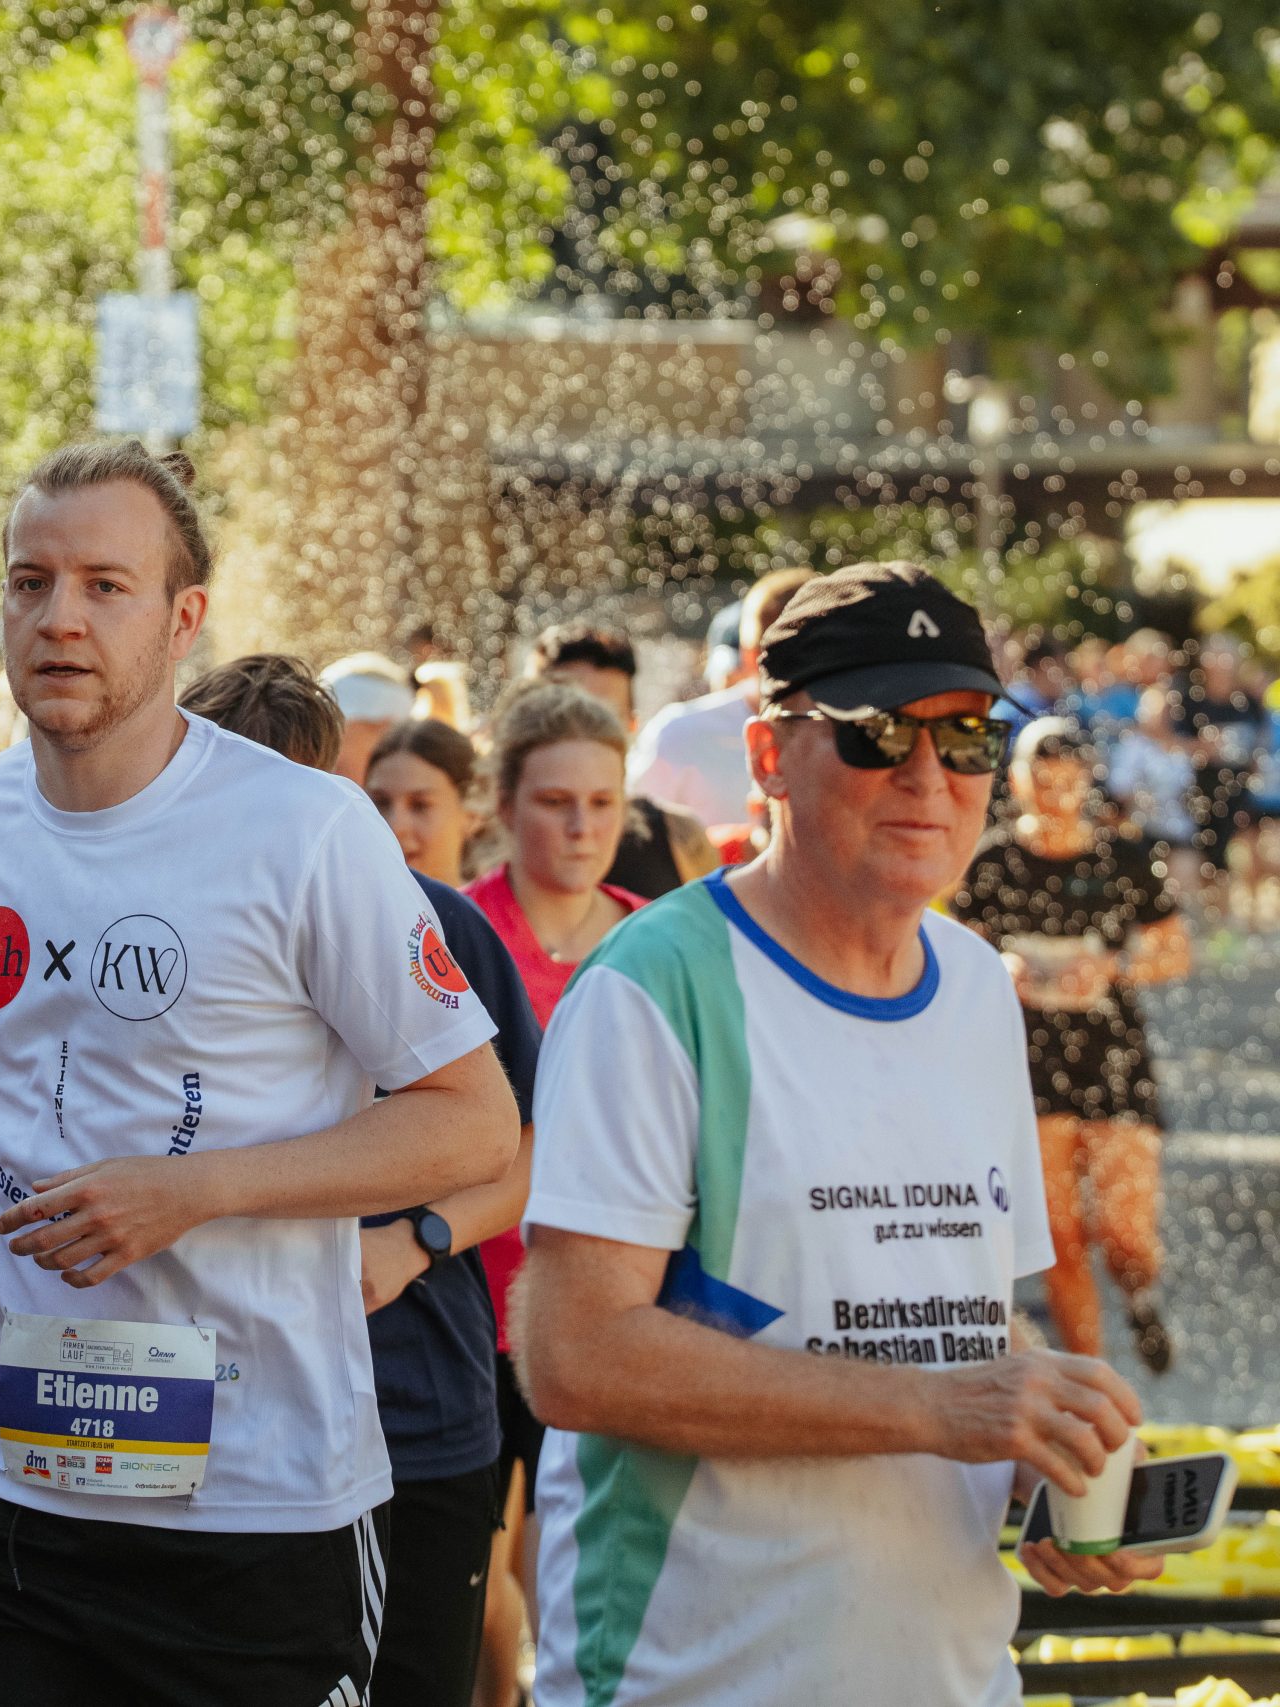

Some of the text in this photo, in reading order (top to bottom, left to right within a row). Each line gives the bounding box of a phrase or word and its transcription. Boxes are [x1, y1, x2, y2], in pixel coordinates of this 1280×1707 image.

[410, 914, 426, 941] Bad
[98, 941, 179, 995] KW
[407, 941, 460, 1009] Firmenlauf
[54, 1040, 68, 1139] ETIENNE
[809, 1183, 980, 1211] SIGNAL IDUNA
[874, 1217, 982, 1244] gut zu wissen
[62, 1350, 84, 1360] LAUF
[63, 1341, 84, 1350] FIRMEN
[37, 1372, 159, 1413] Etienne
[70, 1418, 114, 1438] 4718
[26, 1450, 47, 1469] dm
[120, 1462, 180, 1472] BIONTECH
